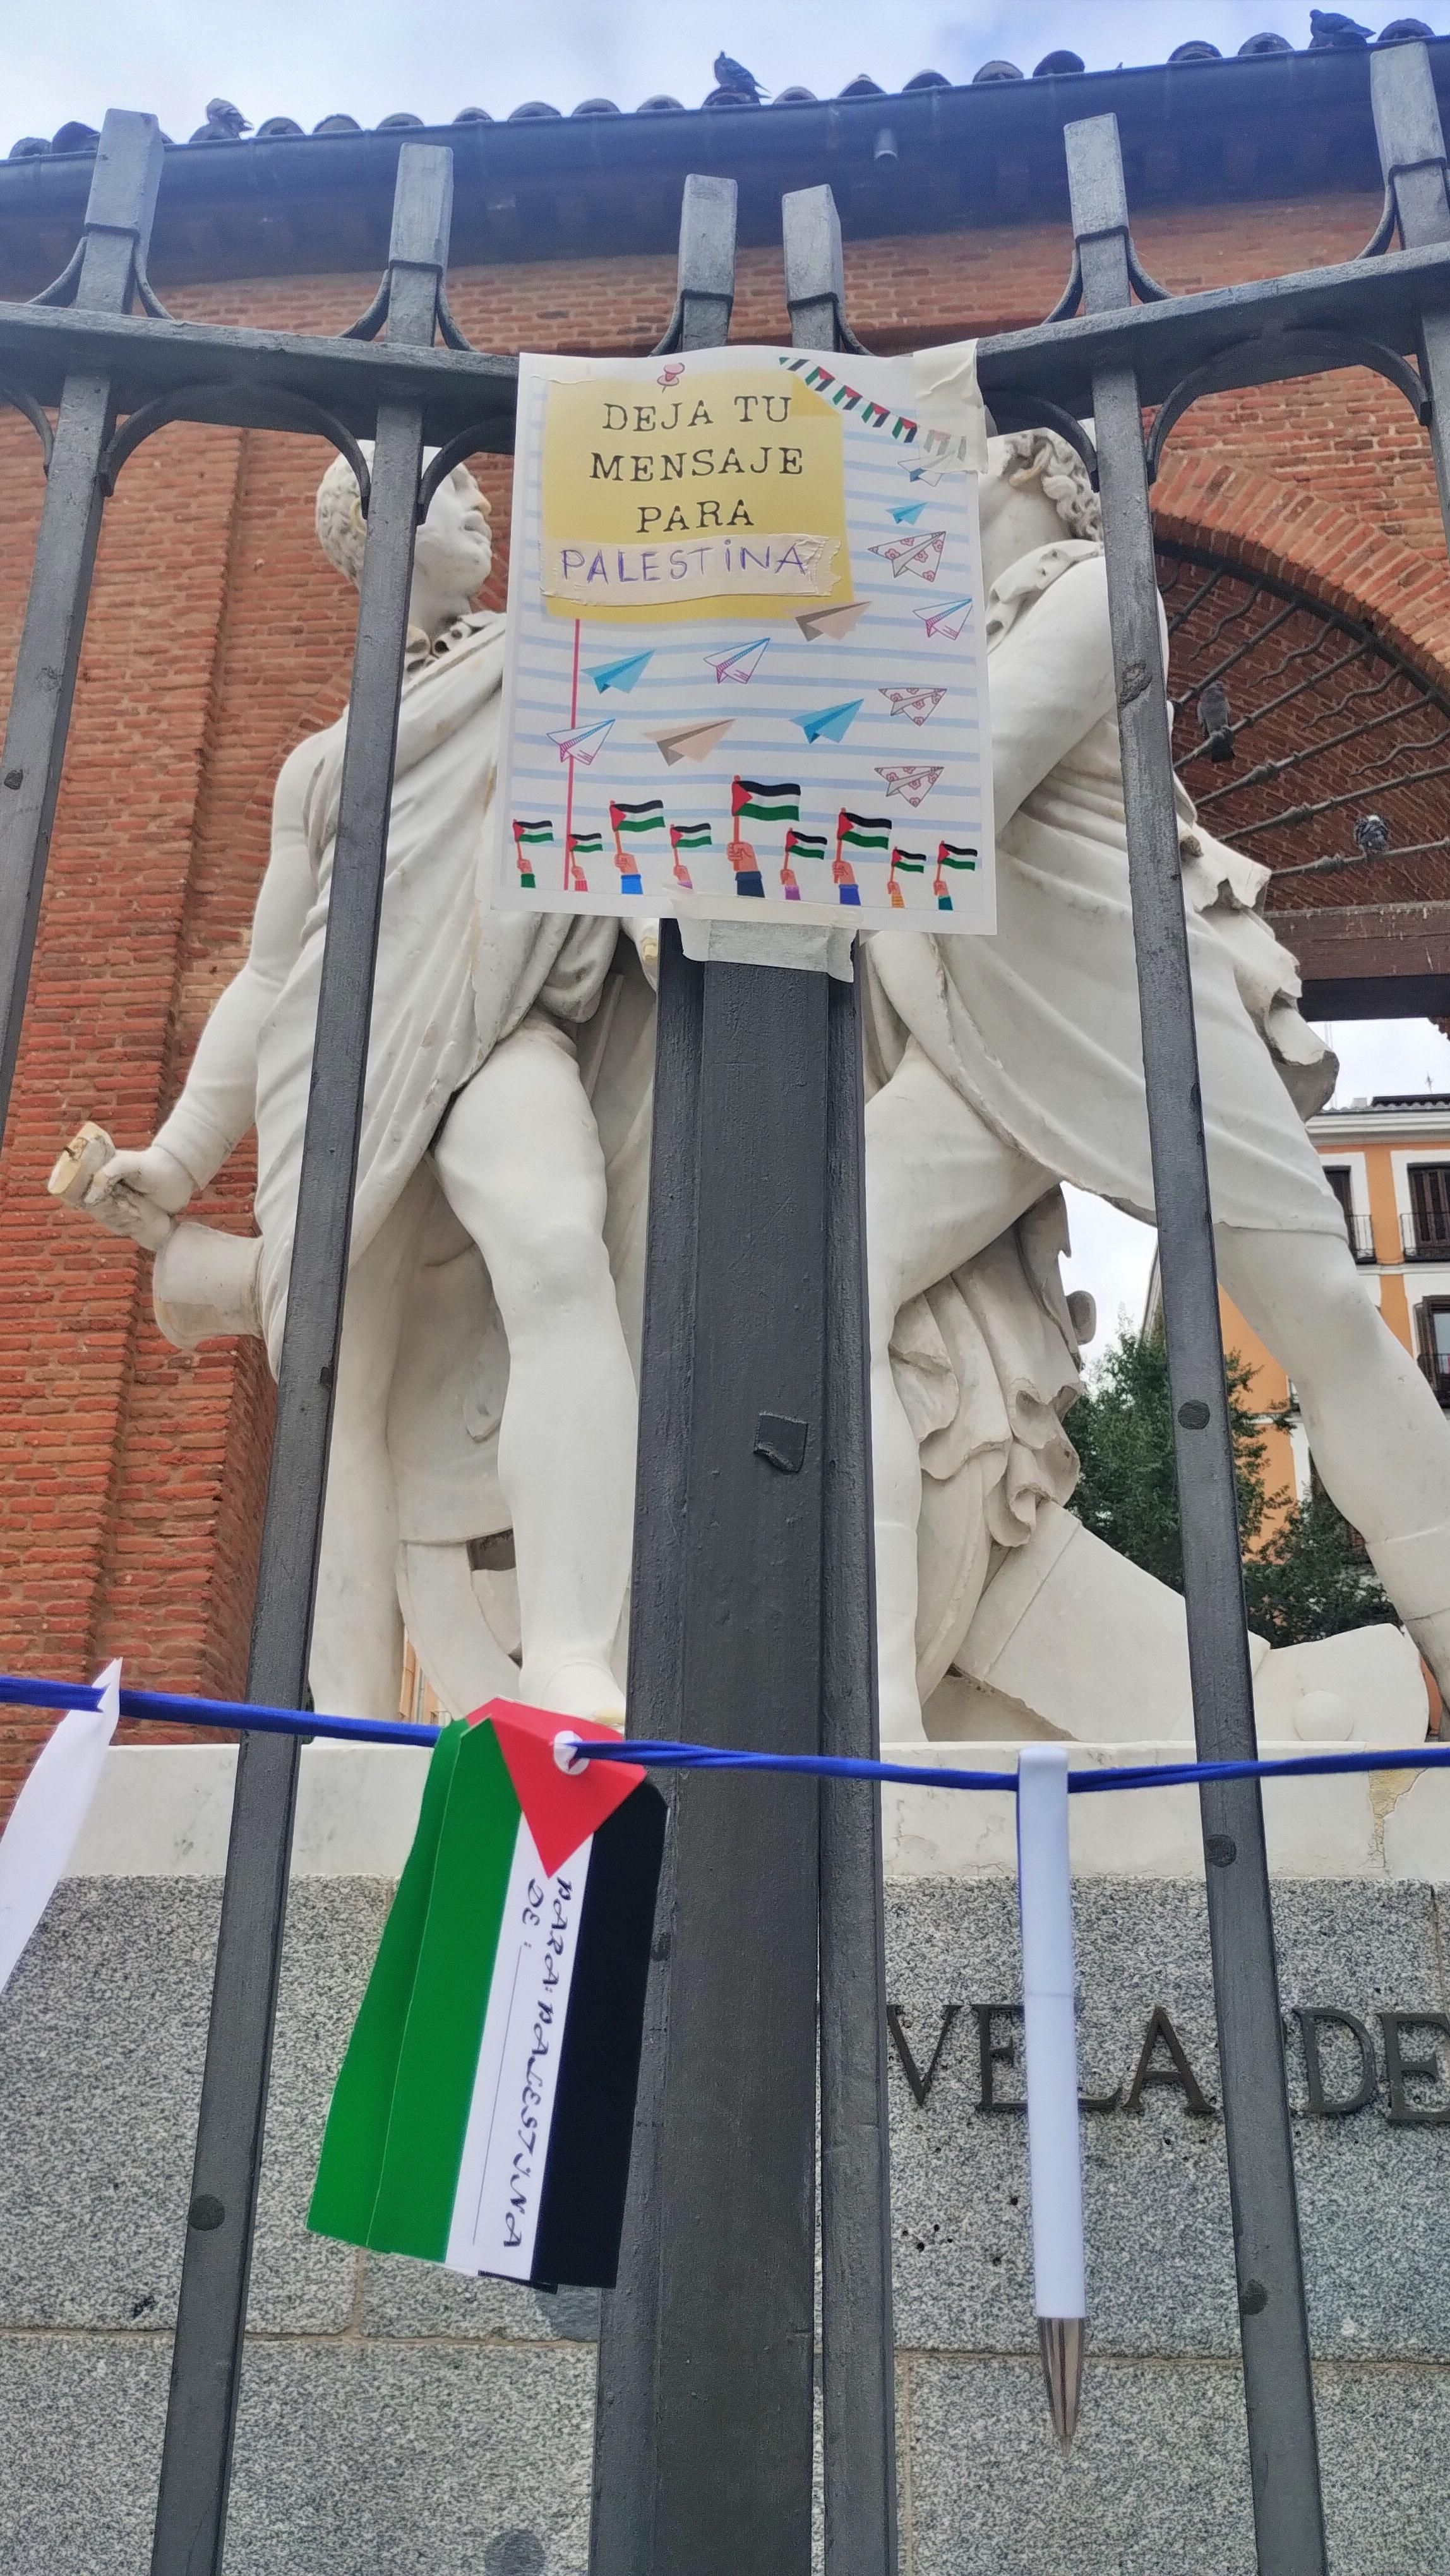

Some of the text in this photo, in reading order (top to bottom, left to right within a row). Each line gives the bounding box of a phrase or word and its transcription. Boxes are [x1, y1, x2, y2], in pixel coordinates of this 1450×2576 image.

[602, 396, 791, 431] DEJA TU
[590, 448, 803, 482] MENSAJE
[637, 499, 753, 532] PARA
